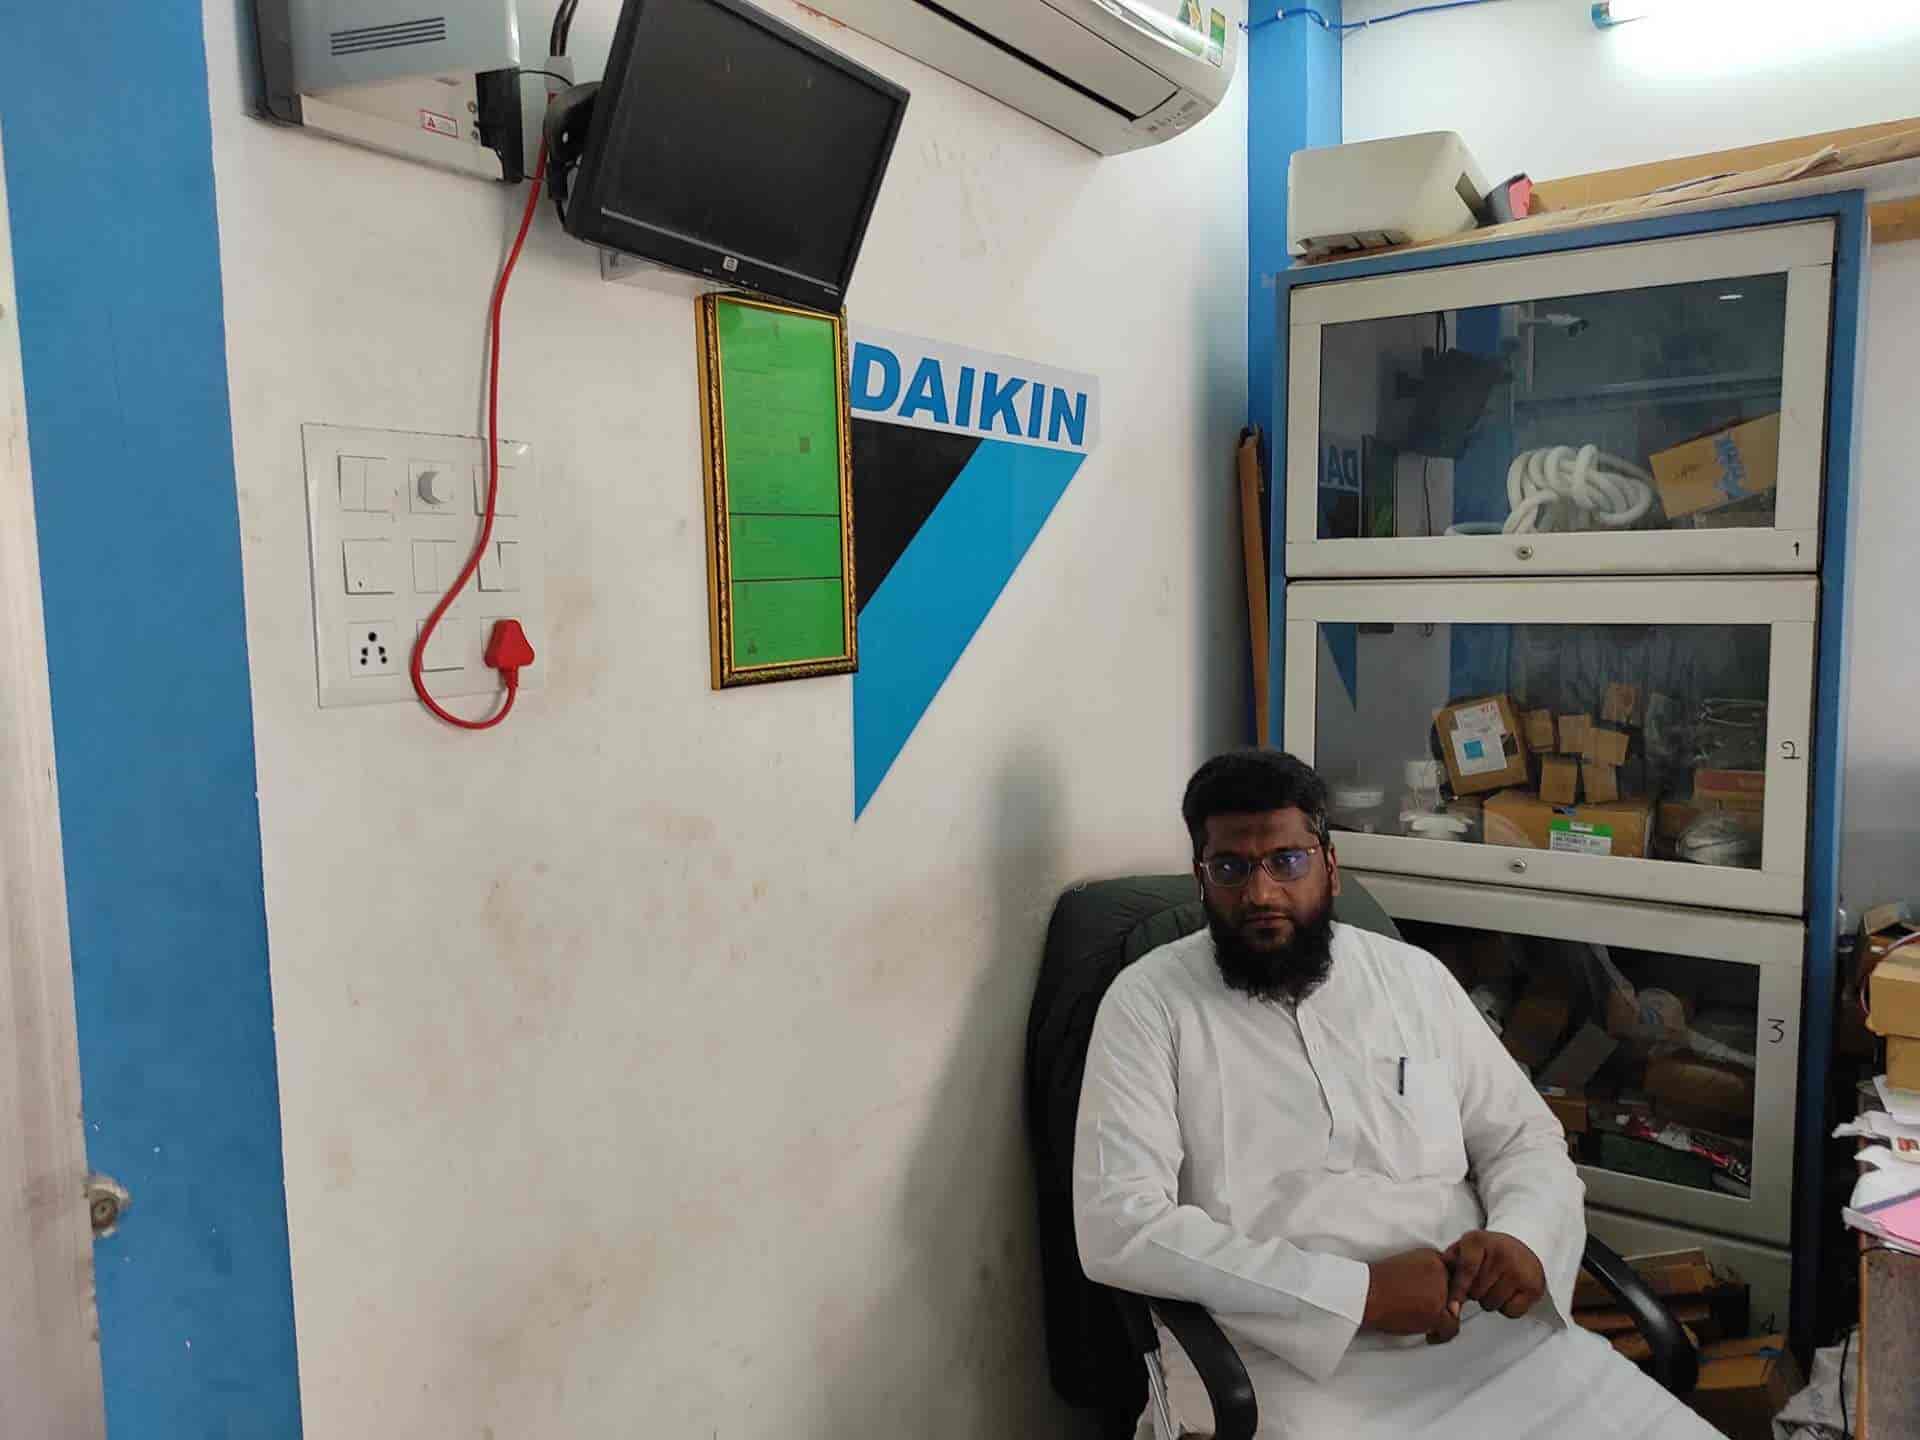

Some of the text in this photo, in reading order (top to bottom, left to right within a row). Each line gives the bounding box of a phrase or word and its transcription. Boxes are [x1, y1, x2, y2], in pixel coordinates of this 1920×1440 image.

[851, 341, 1088, 447] DAIKIN
[1792, 541, 1800, 557] 1
[1781, 740, 1801, 760] 2
[1768, 1018, 1785, 1044] 3
